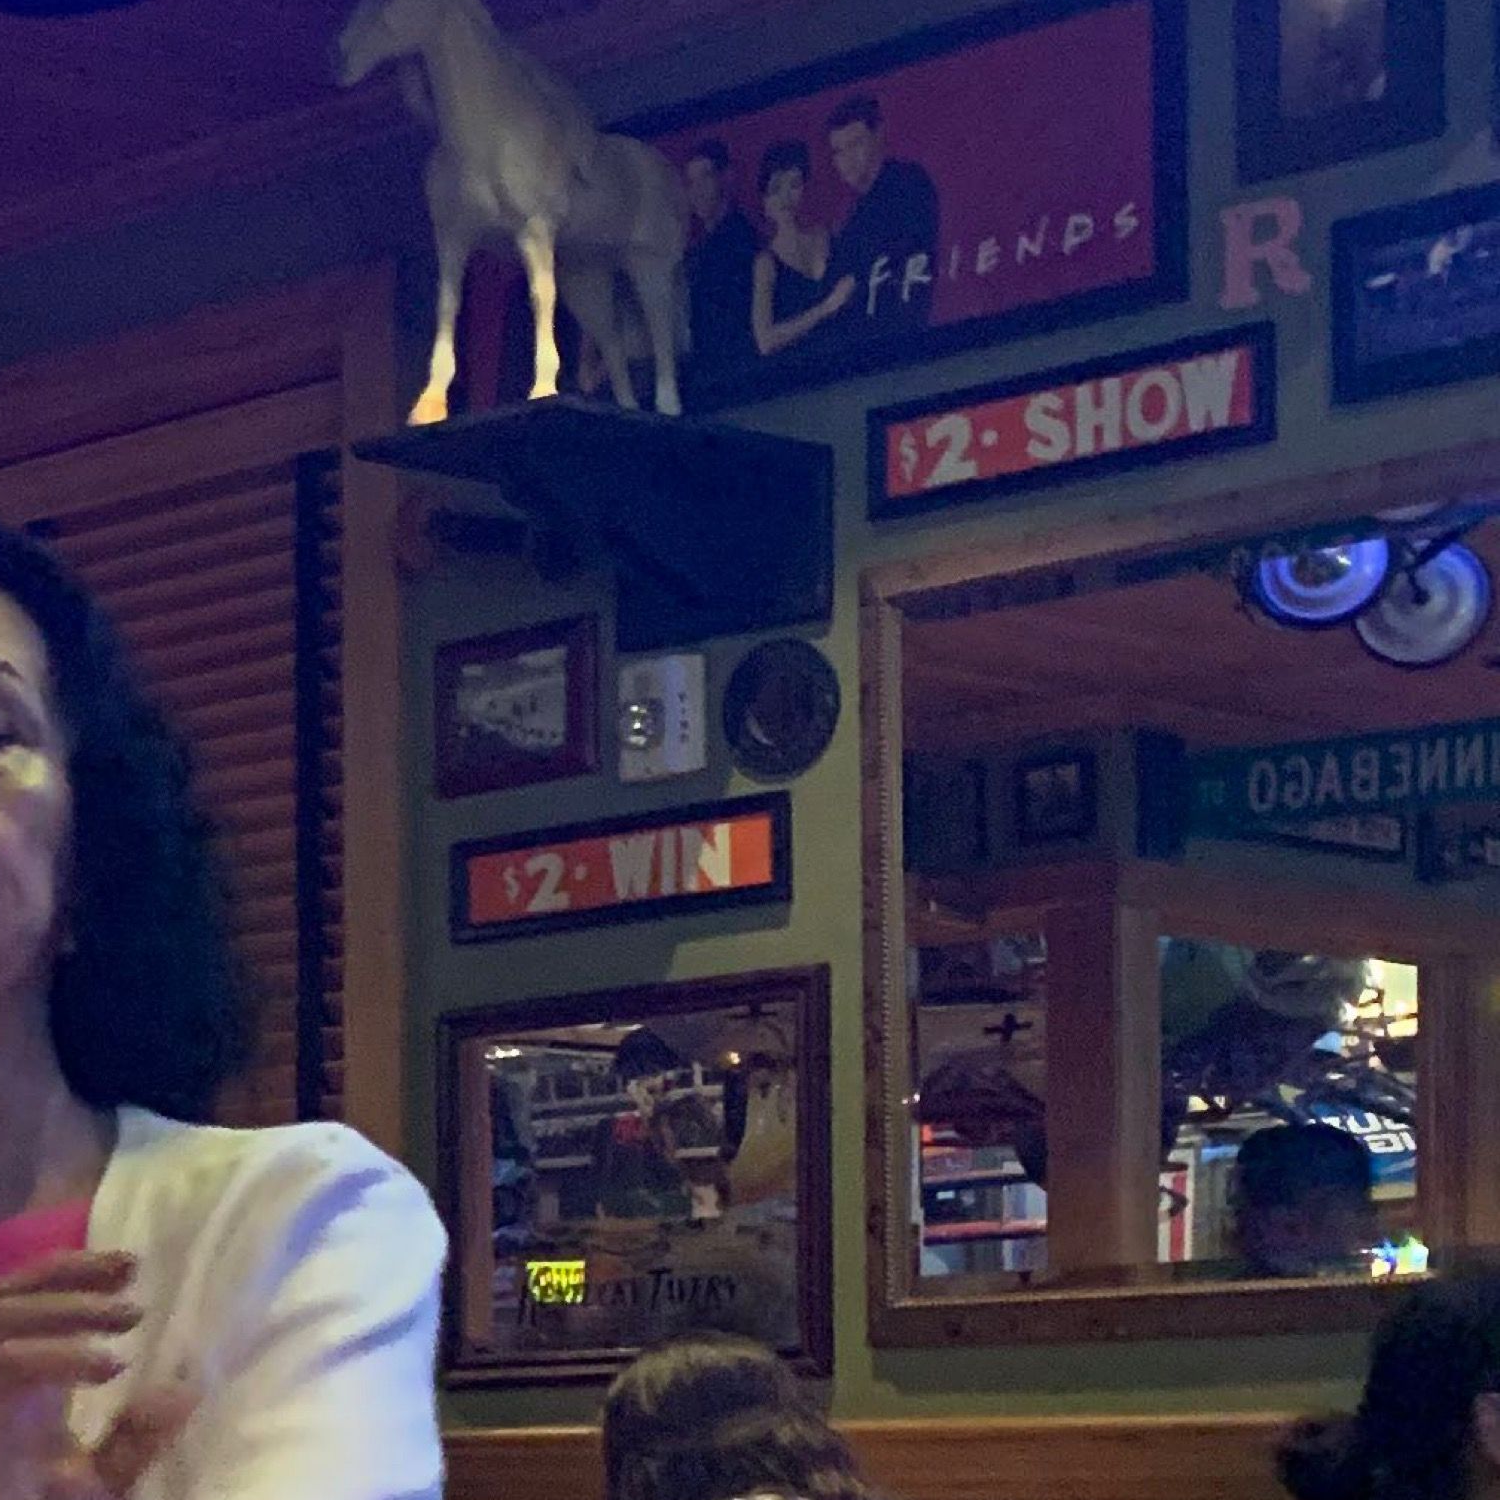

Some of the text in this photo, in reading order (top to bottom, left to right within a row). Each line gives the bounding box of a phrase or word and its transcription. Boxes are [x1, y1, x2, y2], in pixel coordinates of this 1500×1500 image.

[1220, 197, 1313, 309] R
[1023, 350, 1240, 462] SHOW
[609, 822, 731, 900] WIN
